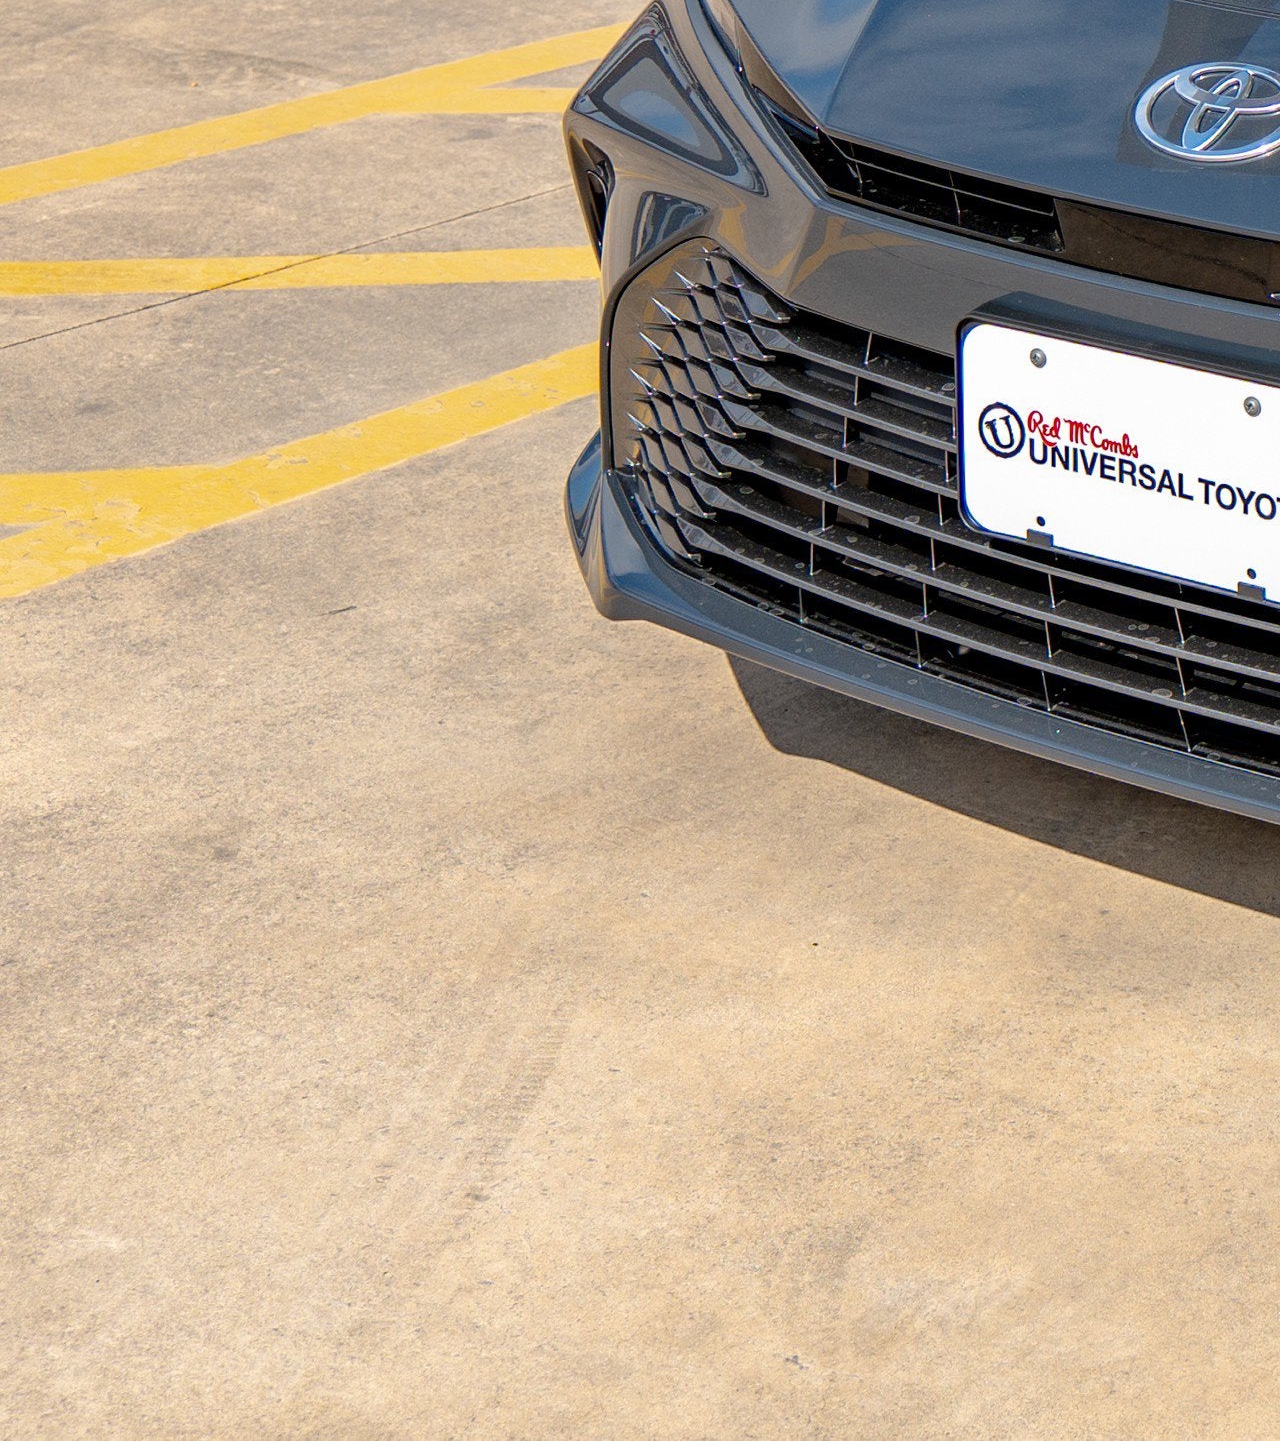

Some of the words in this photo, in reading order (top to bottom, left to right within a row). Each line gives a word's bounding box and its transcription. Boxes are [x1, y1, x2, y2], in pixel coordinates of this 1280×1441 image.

[1026, 410, 1061, 448] Red
[1063, 418, 1139, 458] McCombs
[1028, 436, 1195, 502] UNIVERSAL
